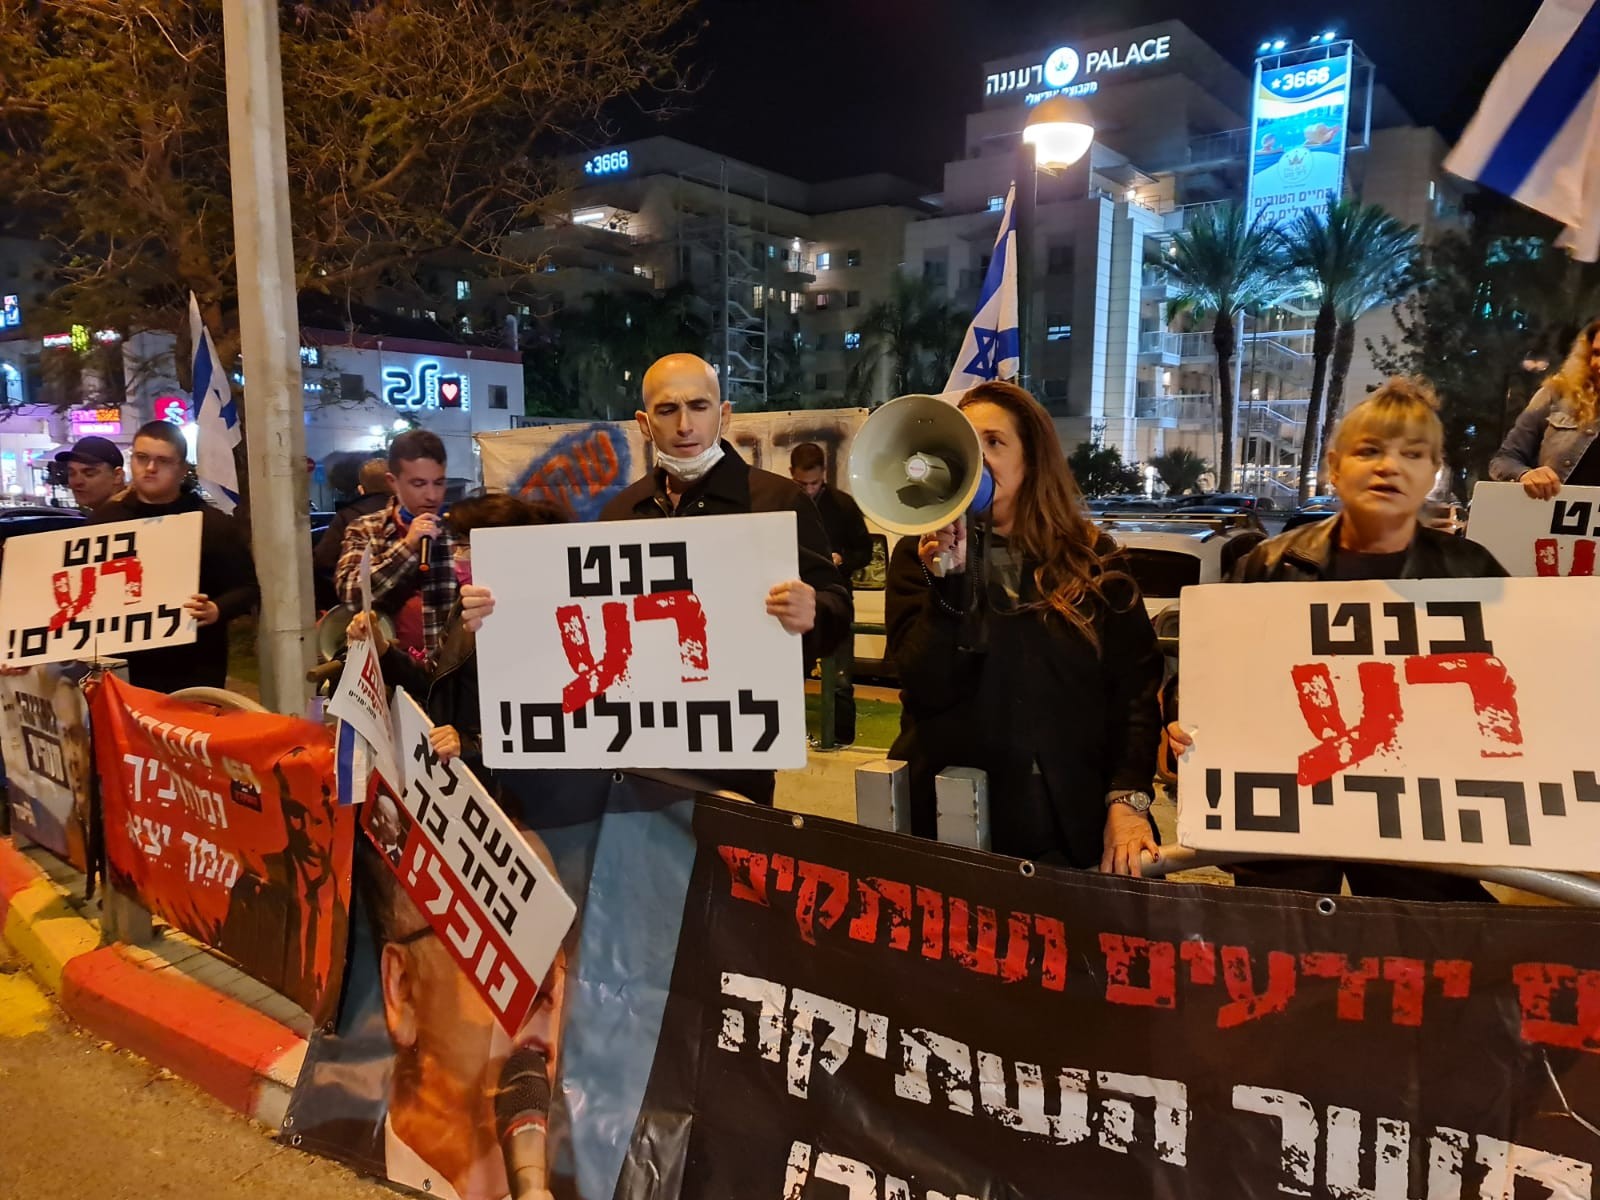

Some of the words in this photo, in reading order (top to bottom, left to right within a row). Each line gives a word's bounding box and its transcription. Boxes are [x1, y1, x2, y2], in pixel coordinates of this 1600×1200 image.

[986, 64, 1043, 96] רעננה
[1086, 36, 1171, 74] PALACE
[63, 532, 137, 567] בנט
[567, 541, 693, 598] בנט
[52, 556, 143, 631] רע
[1310, 601, 1494, 656] בנט
[7, 604, 181, 659] לחיילים!
[555, 589, 709, 714] רע
[500, 689, 779, 753] לחיילים!
[1290, 652, 1523, 786] רע
[413, 732, 459, 796] לא
[462, 795, 536, 902] העם
[458, 837, 517, 936] בחר
[718, 845, 1068, 992] ושותקים
[407, 843, 519, 1013] נוכל!
[1099, 932, 1472, 1029] יודעים
[717, 971, 1189, 1168] השתיקה
